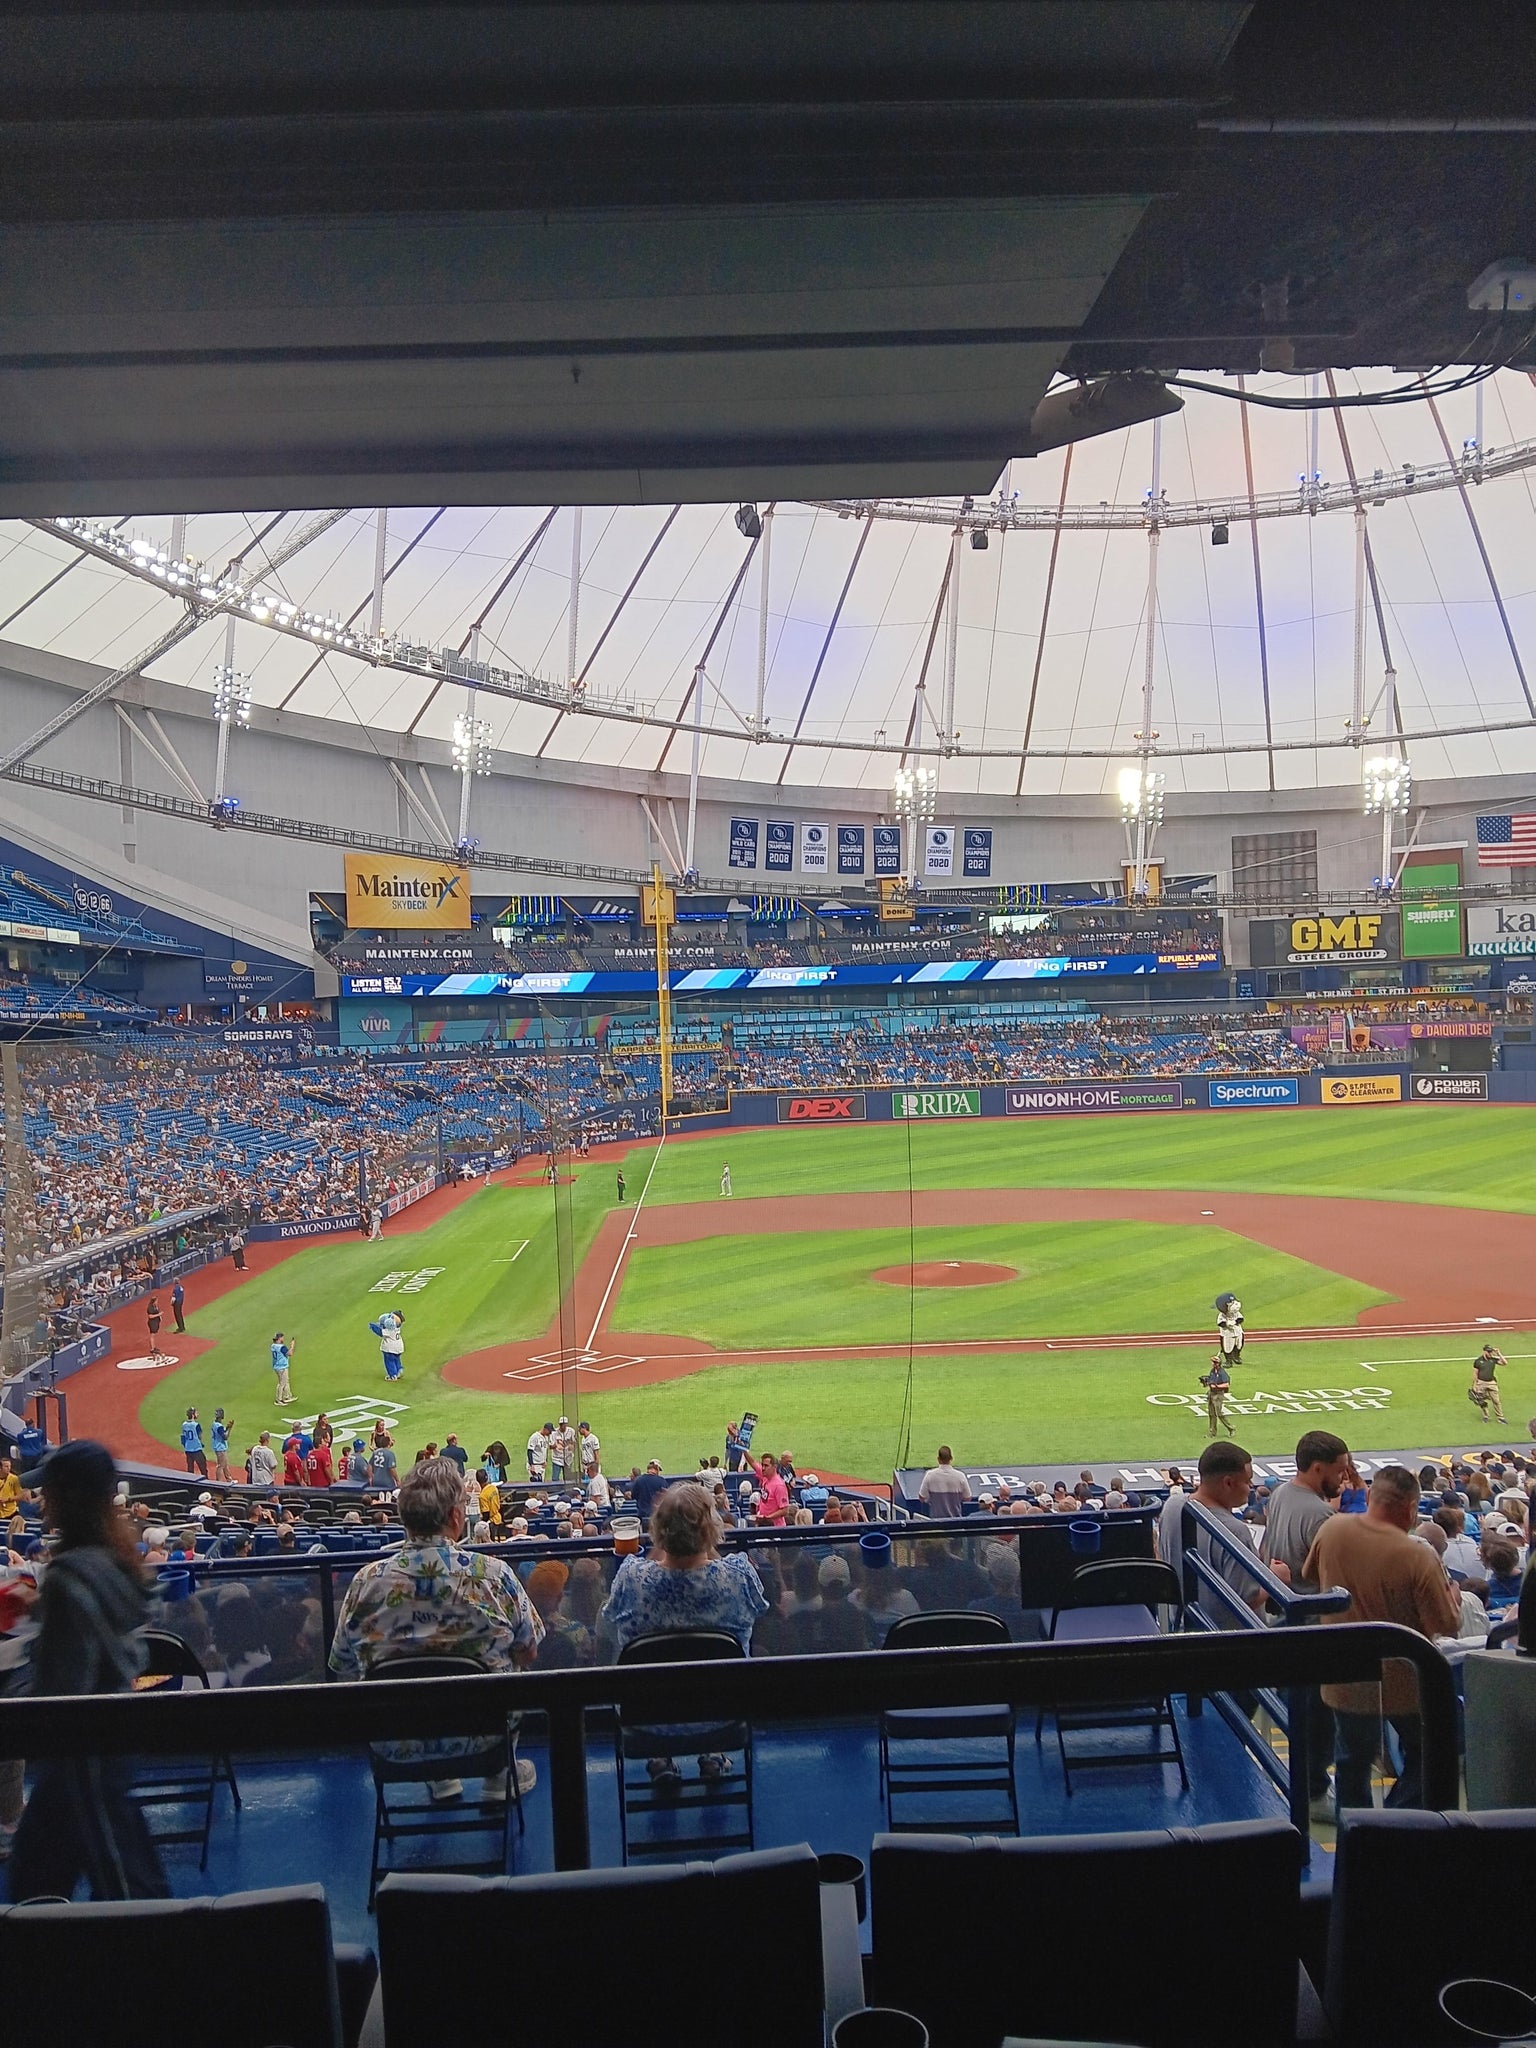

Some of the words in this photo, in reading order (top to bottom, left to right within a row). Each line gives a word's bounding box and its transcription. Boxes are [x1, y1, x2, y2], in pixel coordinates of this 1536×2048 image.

[769, 853, 790, 864] 2008
[804, 856, 824, 864] 2008
[842, 856, 860, 867] 2010
[878, 856, 896, 867] 2020
[929, 858, 949, 868] 2020
[968, 860, 986, 870] 2021
[356, 874, 460, 908] MaintenX
[76, 893, 87, 908] 42
[90, 896, 98, 910] 12
[392, 900, 428, 910] SKYDECK
[1407, 910, 1456, 920] SUNBELT
[1292, 916, 1382, 951] GMF
[852, 940, 951, 951] MAINTENX.COM
[366, 949, 472, 958] MAINTENX.COM
[1158, 954, 1194, 963] REPUBLIC
[1195, 953, 1216, 961] BANK
[1294, 952, 1334, 960] STEEL
[1338, 951, 1380, 959] GROUP
[1064, 960, 1108, 971] FIRST
[796, 970, 838, 981] FIRST
[226, 982, 254, 990] TERRACE
[352, 979, 382, 987] LISTEN
[528, 978, 571, 987] FIRST
[360, 1018, 391, 1032] VIVA
[1427, 1024, 1468, 1036] DAIQUIRI
[224, 1031, 264, 1041] SOMOS
[265, 1030, 293, 1040] RAYS
[1434, 1080, 1480, 1088] POWER
[1216, 1084, 1286, 1100] Spectrum
[1350, 1088, 1394, 1096] CLEARWATER
[1434, 1087, 1481, 1095] DESIGN
[919, 1092, 972, 1116] RIPA
[1120, 1094, 1174, 1105] MORTGAGE
[788, 1098, 854, 1118] DEX
[281, 1222, 331, 1237] RAYMOND
[1187, 1399, 1390, 1416] HEALTH
[308, 1459, 318, 1470] 30
[374, 1455, 384, 1468] 22
[967, 1472, 1026, 1489] TB
